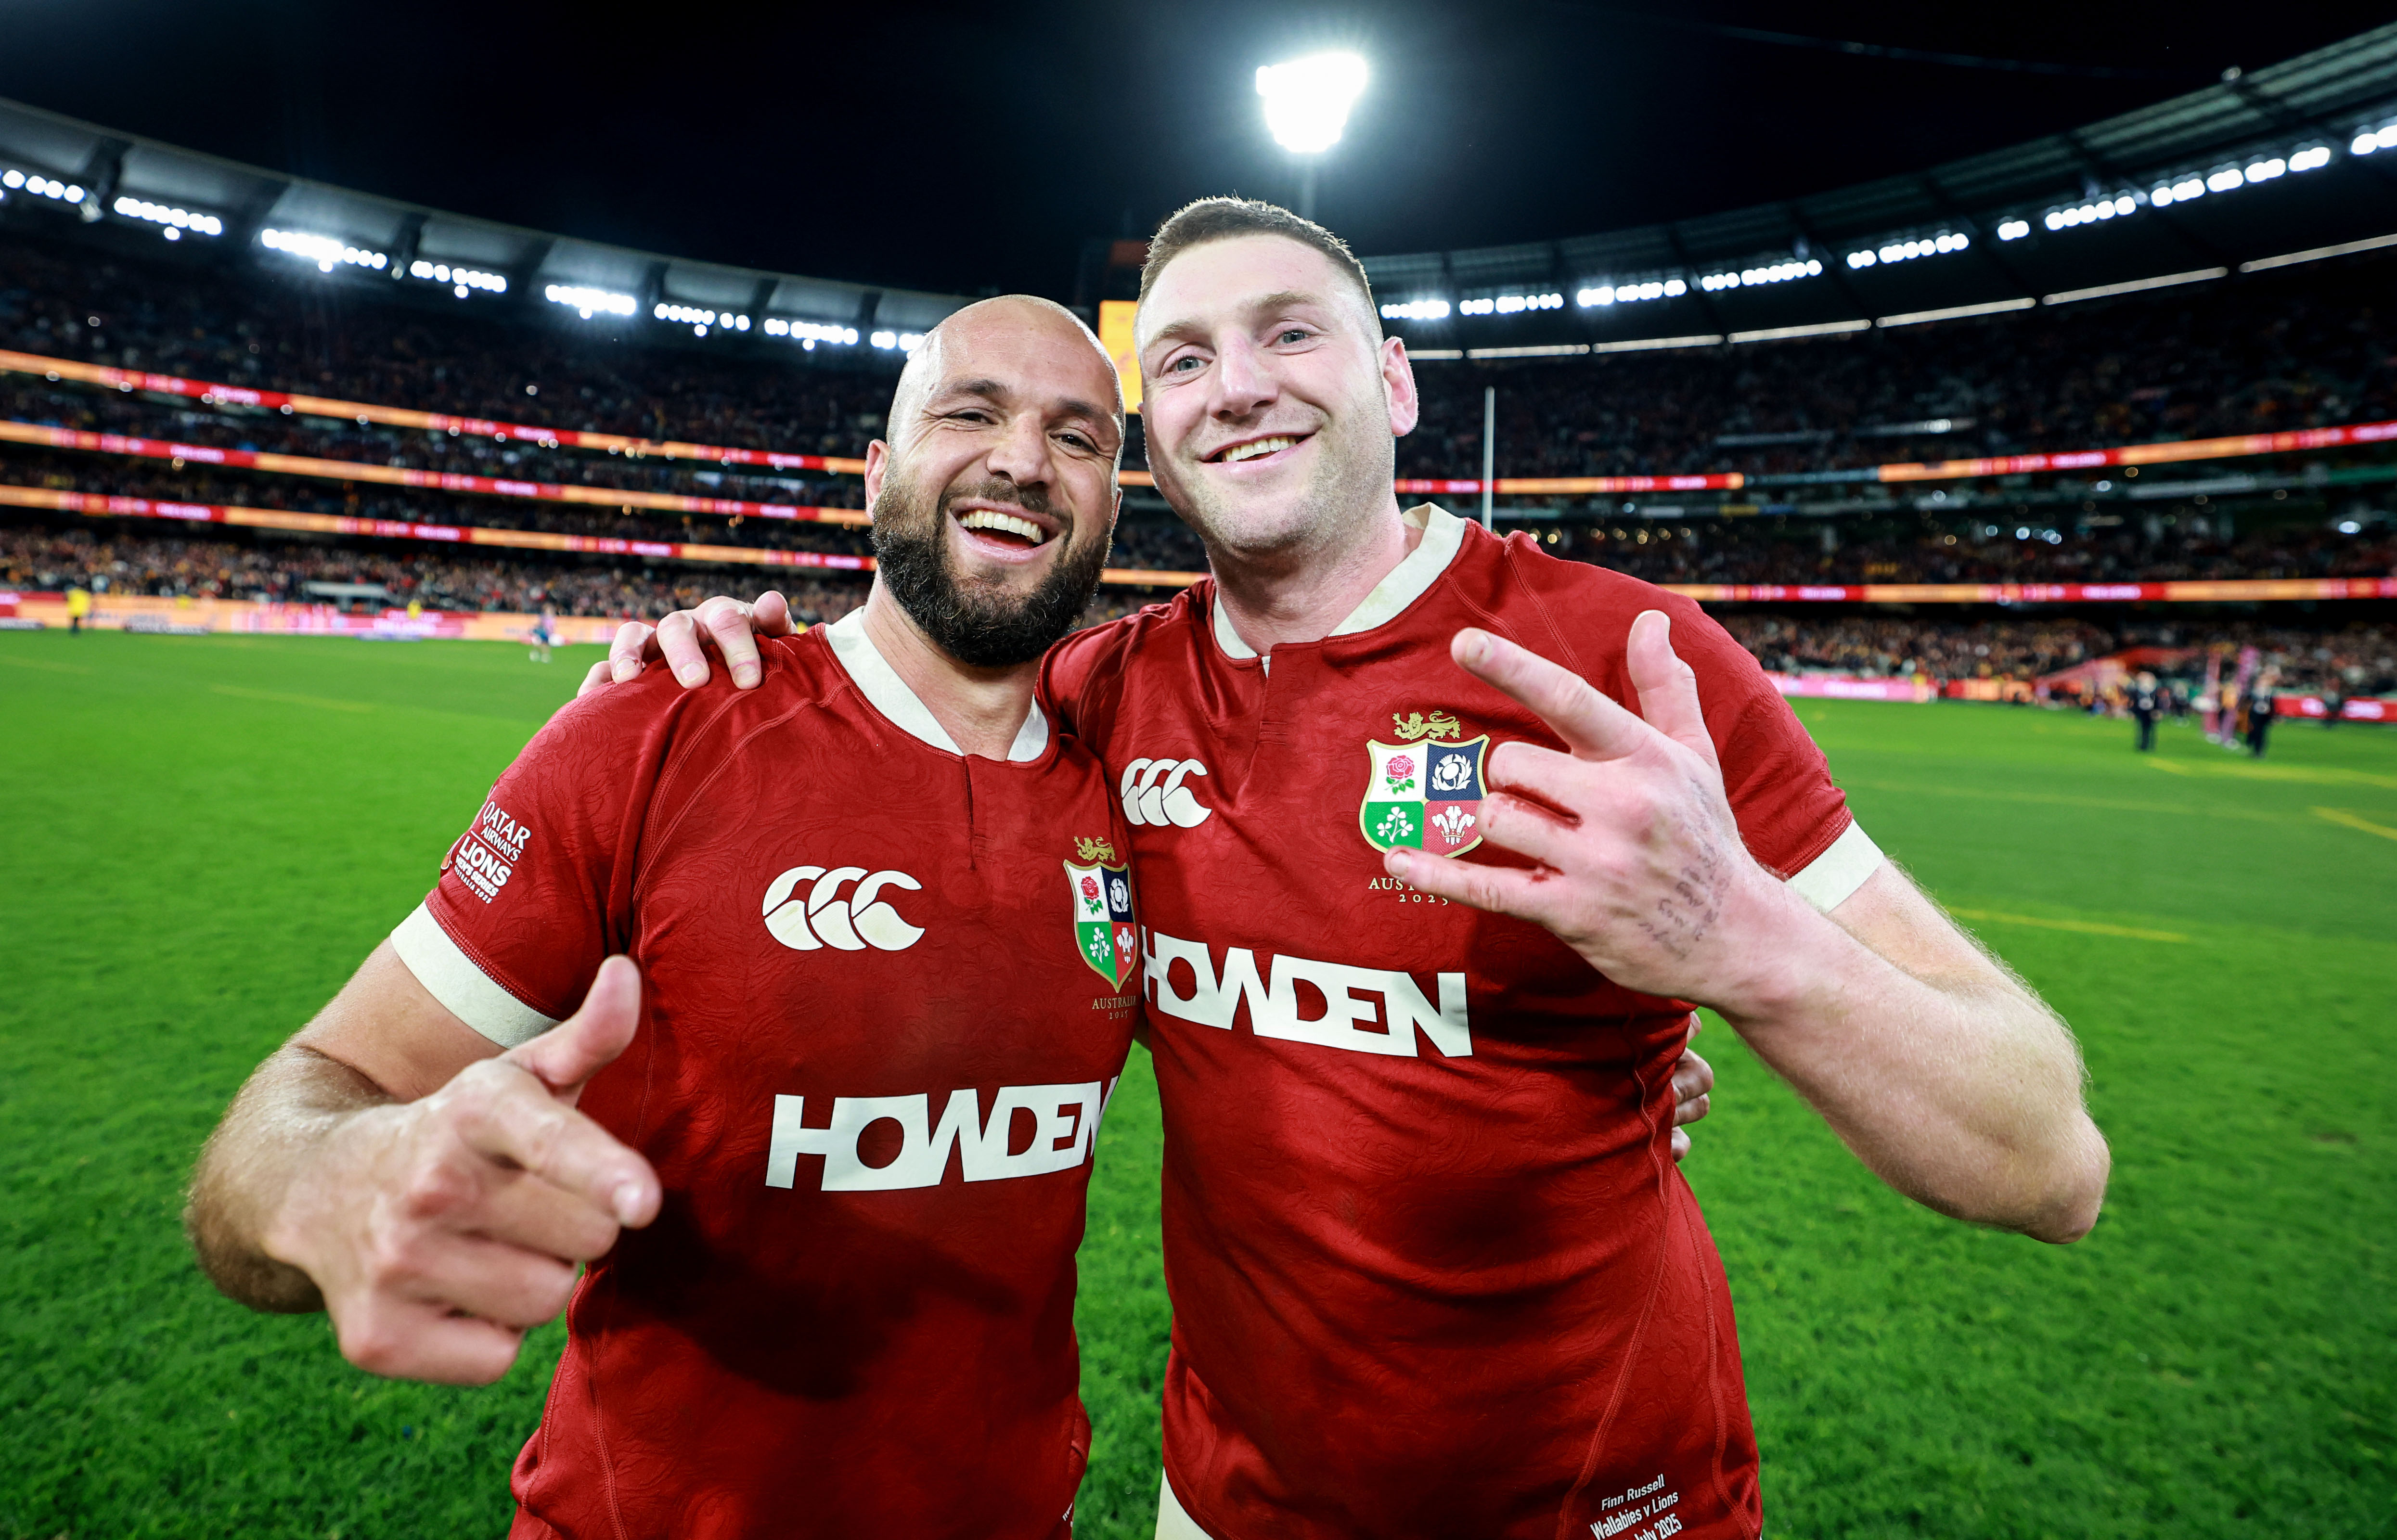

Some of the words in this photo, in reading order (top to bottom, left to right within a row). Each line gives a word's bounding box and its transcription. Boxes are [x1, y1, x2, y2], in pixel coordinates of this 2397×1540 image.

[481, 825, 521, 861] AIRWAYS
[483, 801, 531, 849] QATAR
[459, 835, 512, 886] LIONS
[454, 865, 476, 891] AUSTRALIA
[475, 888, 493, 904] 2025
[470, 871, 500, 897] SERIES
[1141, 924, 1473, 1058] HOWDEN
[765, 1075, 1119, 1192] HOWDEN
[1601, 1495, 1624, 1511] Finn
[1627, 1473, 1665, 1501] Russell
[1590, 1509, 1642, 1540] Wallabies
[1643, 1505, 1650, 1517] v
[1652, 1491, 1679, 1514] Lions
[1654, 1513, 1683, 1540] 2025
